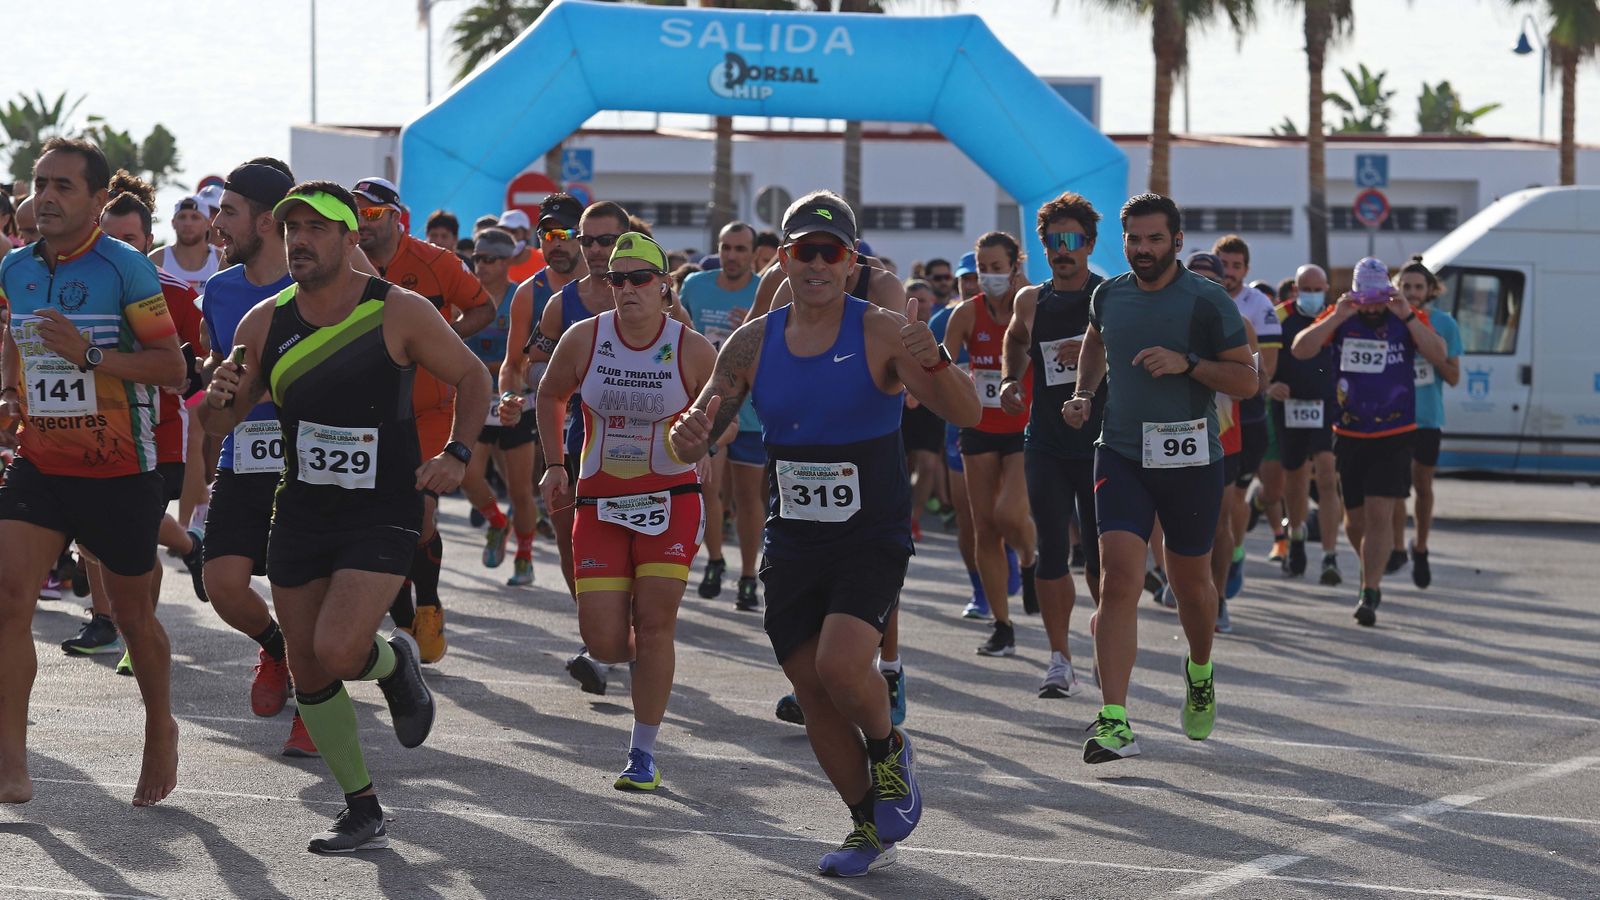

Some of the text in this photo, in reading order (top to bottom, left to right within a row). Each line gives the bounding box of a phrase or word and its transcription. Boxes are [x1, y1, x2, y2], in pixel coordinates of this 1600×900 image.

[659, 18, 855, 56] SALIDA
[725, 52, 819, 89] DORSAL
[1350, 351, 1383, 365] 392
[596, 365, 672, 380] CLUB TRIATLÓN
[35, 379, 86, 402] 141
[603, 377, 663, 389] ALGECIRAS
[599, 389, 665, 415] ANA RIOS
[1293, 409, 1320, 421] 150
[314, 432, 360, 442] CARRERA URBANA
[1163, 437, 1197, 457] 96
[251, 439, 285, 460] 60
[309, 447, 370, 474] 329
[791, 484, 854, 507] 319
[611, 509, 666, 527] 325
